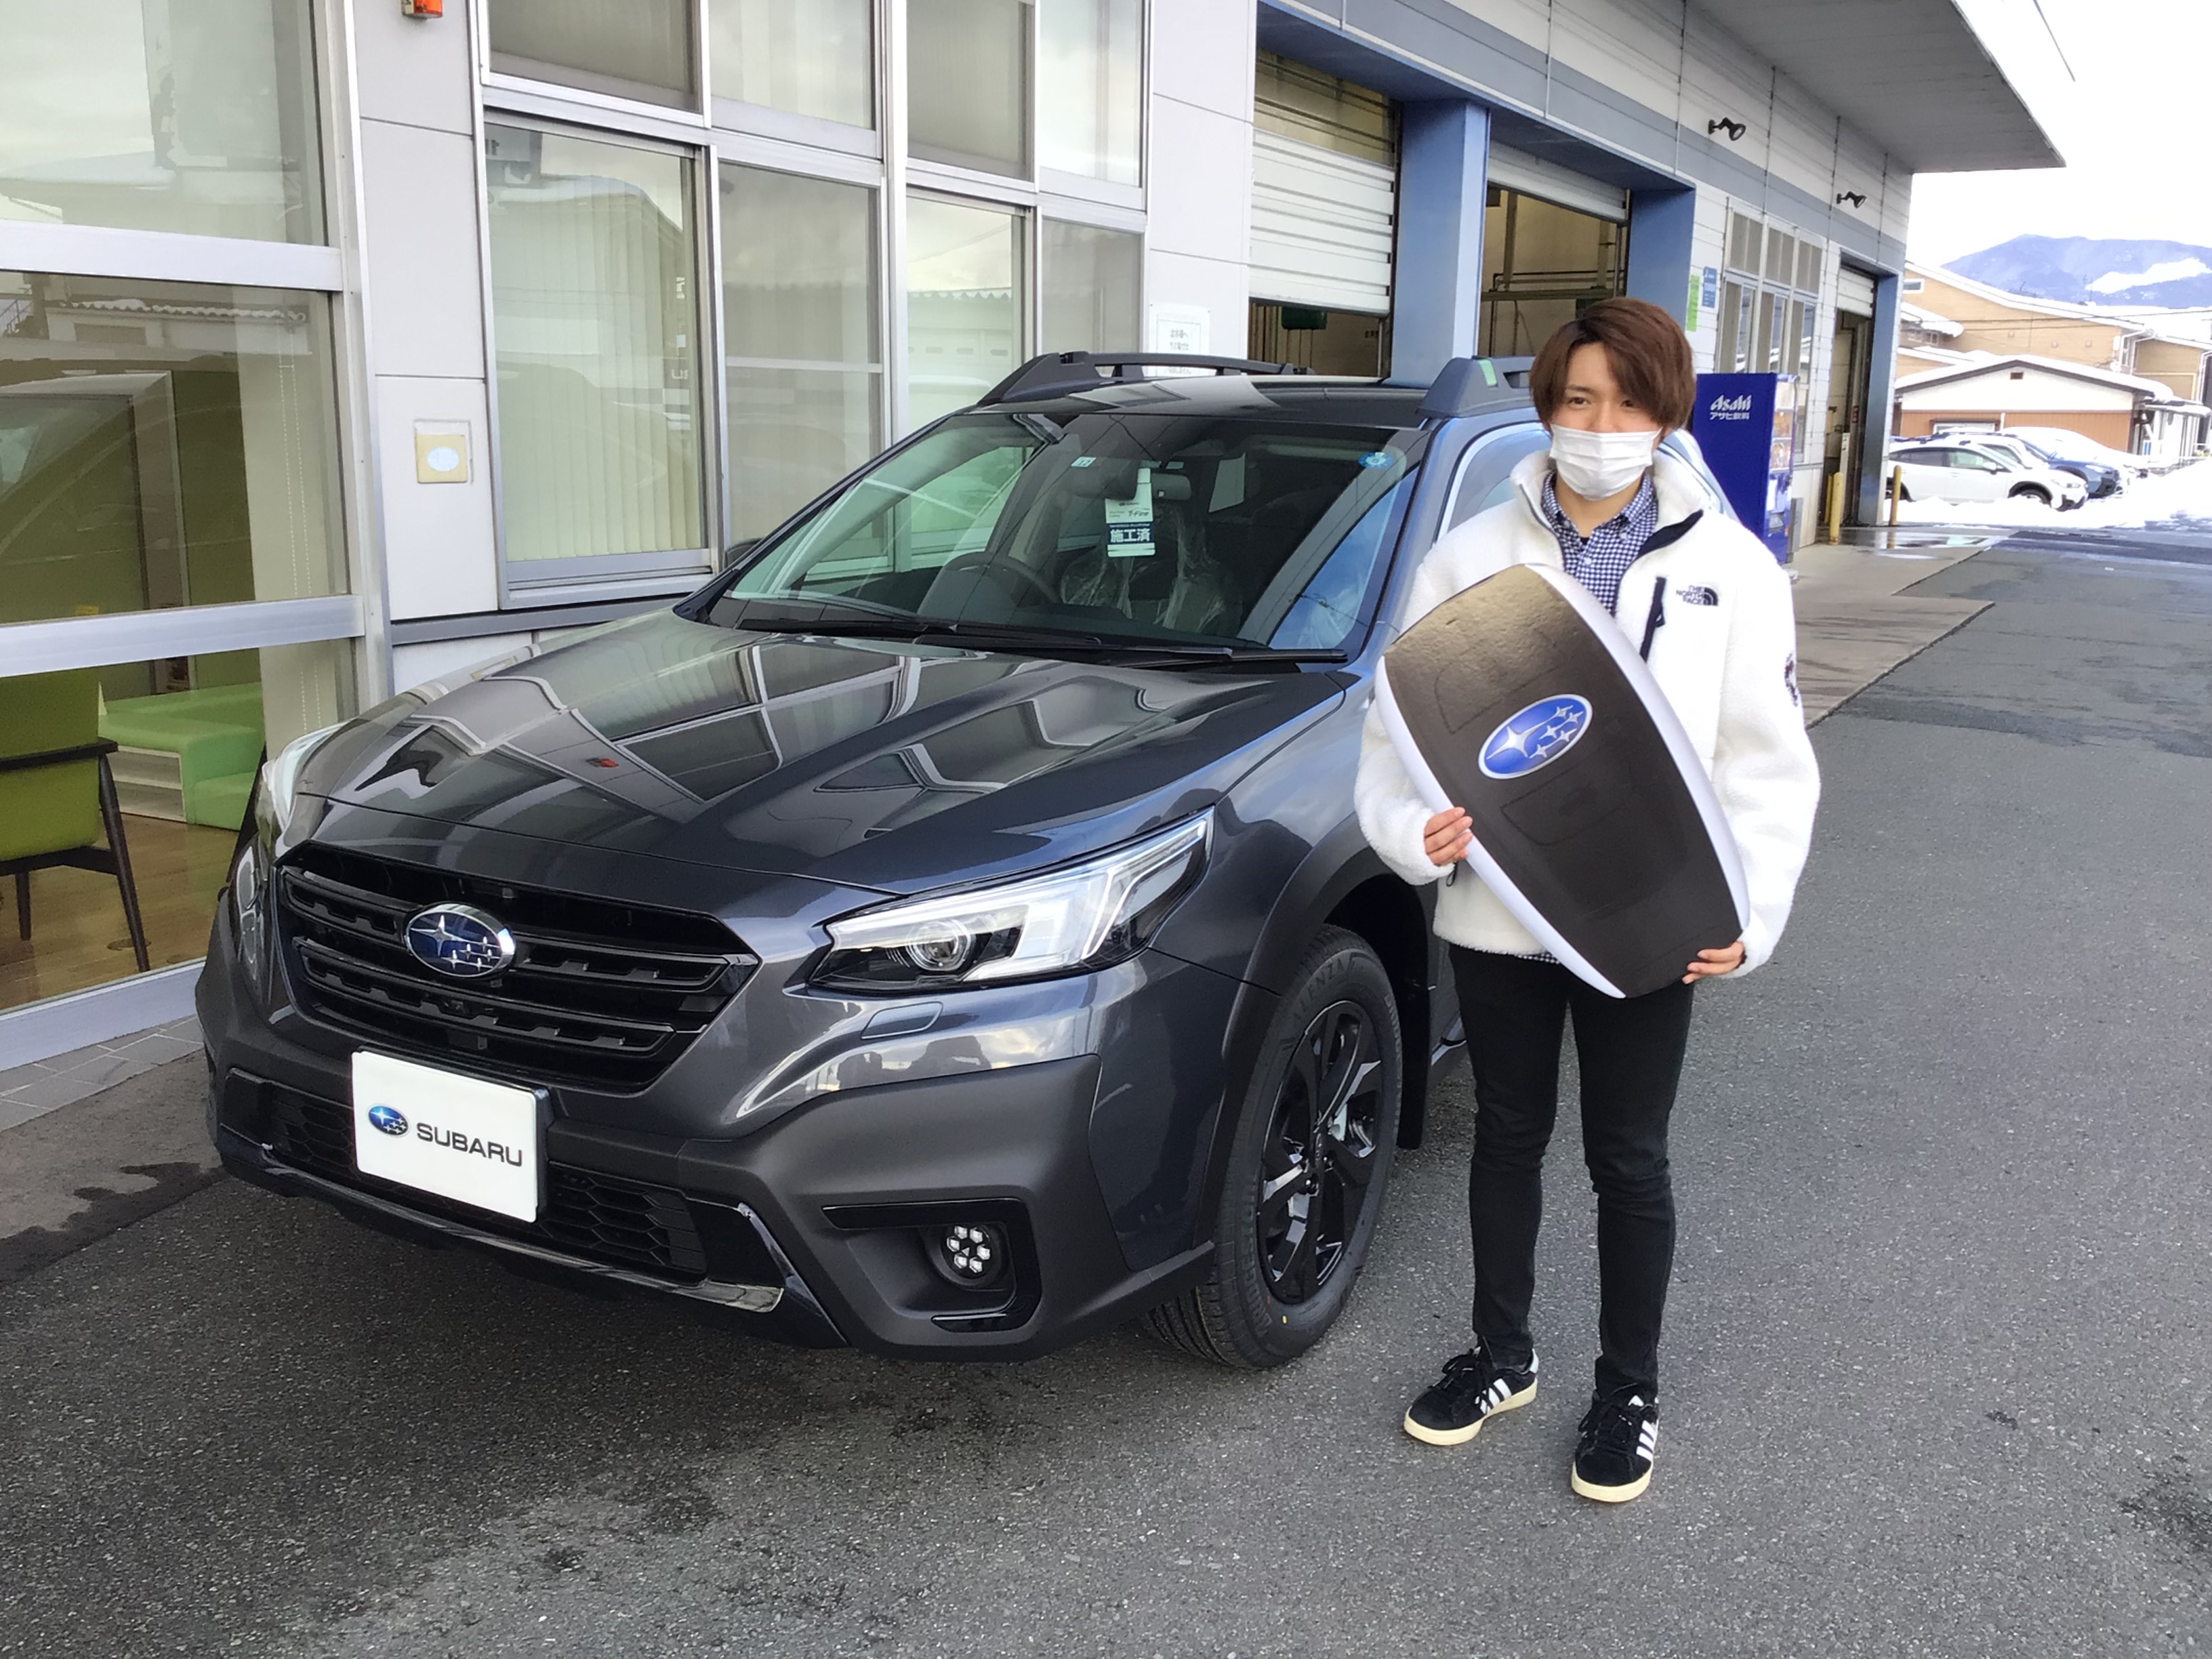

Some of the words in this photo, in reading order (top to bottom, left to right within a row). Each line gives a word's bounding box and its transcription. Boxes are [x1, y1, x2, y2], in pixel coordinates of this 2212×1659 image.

[1710, 394, 1753, 411] Asahi
[1709, 411, 1750, 421] アサヒ飲料
[1110, 528, 1151, 543] 施工済
[1689, 585, 1704, 593] THE
[1675, 590, 1704, 600] NORTH
[1683, 596, 1704, 605] FACE
[416, 1122, 523, 1167] SUBARU
